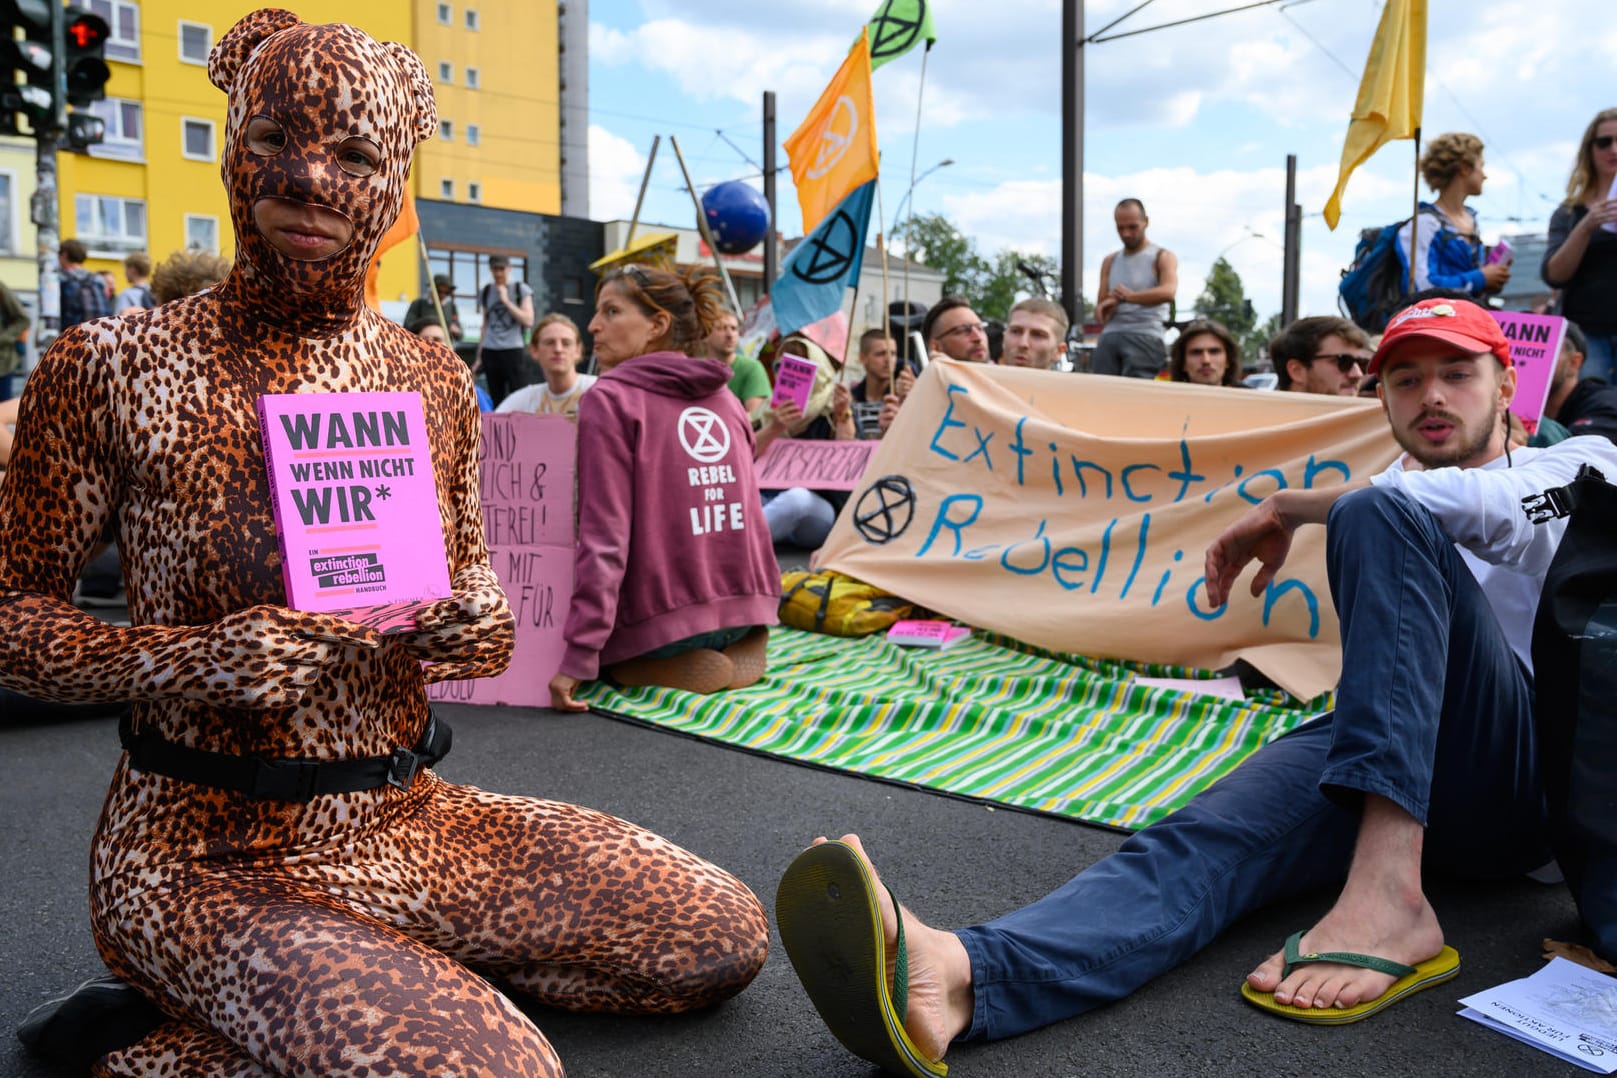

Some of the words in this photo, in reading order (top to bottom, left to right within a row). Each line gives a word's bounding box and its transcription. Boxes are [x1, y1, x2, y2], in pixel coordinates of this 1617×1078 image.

[1514, 346, 1546, 359] NICHT
[279, 411, 410, 450] WANN
[929, 384, 1351, 505] Extinction
[290, 461, 354, 483] WENN
[359, 458, 415, 479] NICHT
[480, 462, 522, 501] LICH
[529, 463, 547, 501] &
[688, 464, 736, 487] REBEL
[704, 487, 724, 501] FOR
[690, 502, 745, 536] LIFE
[313, 555, 369, 573] extinction
[332, 566, 384, 585] rebellion
[508, 551, 542, 583] MIT
[355, 585, 387, 593] HANDBUCH
